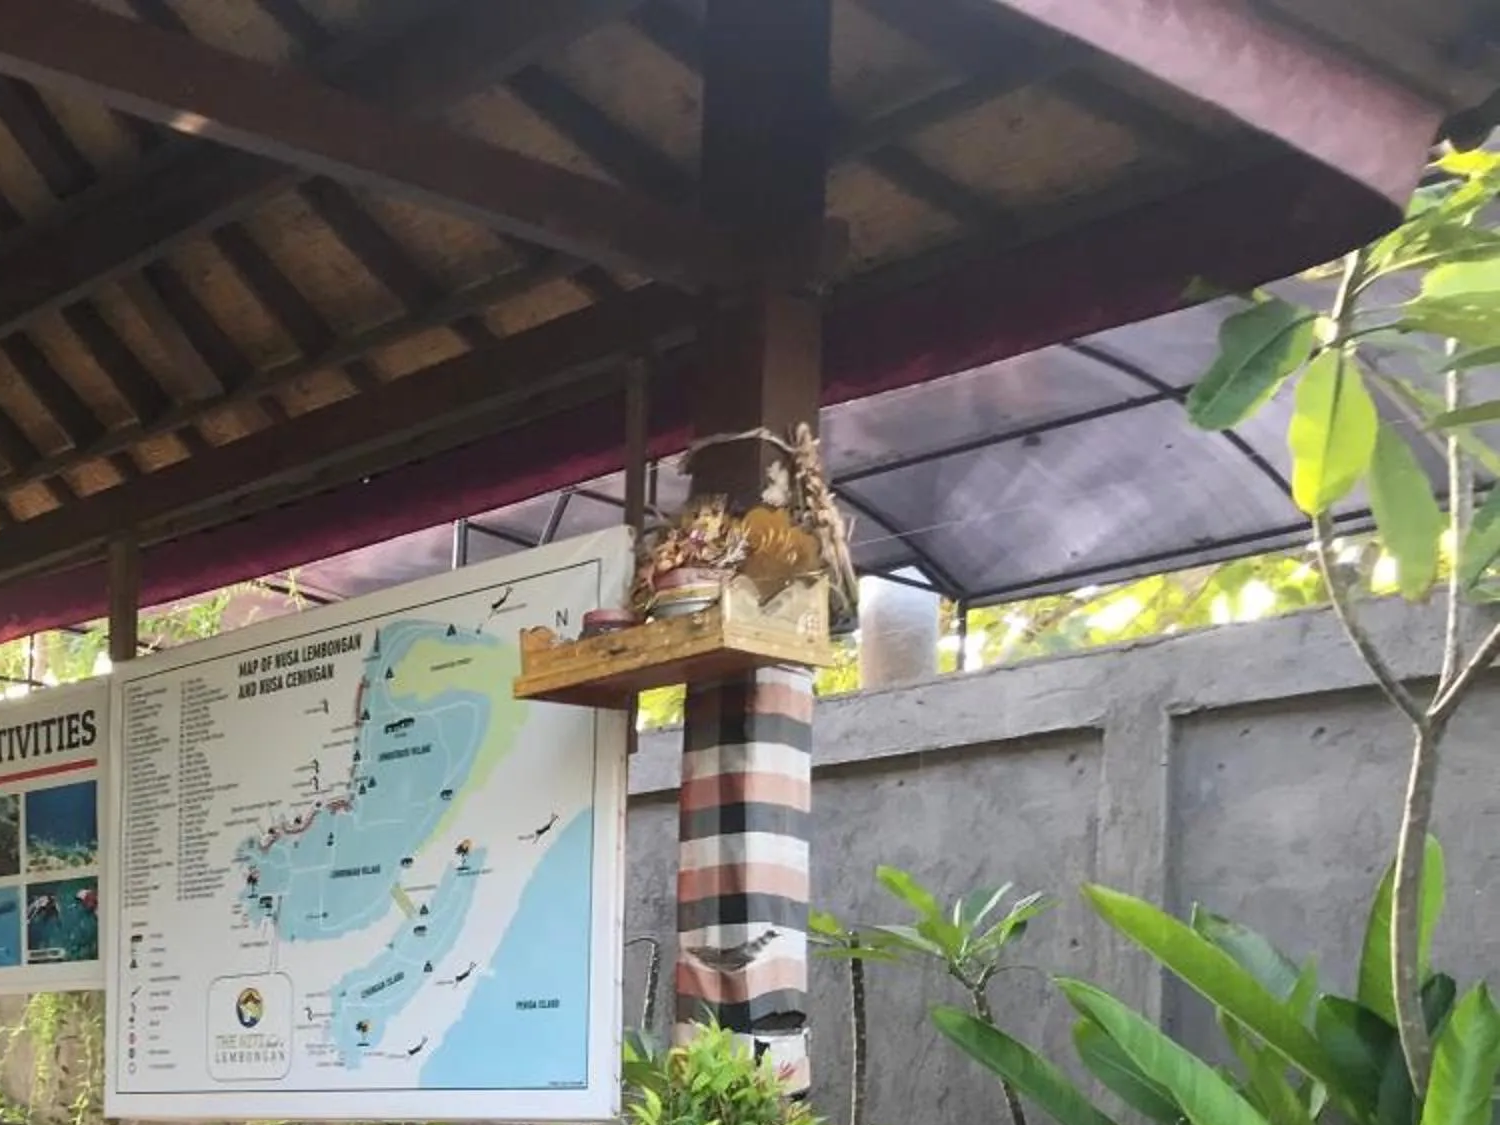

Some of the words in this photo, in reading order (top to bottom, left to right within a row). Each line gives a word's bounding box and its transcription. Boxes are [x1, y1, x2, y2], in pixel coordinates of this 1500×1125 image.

[238, 659, 259, 677] MAP
[260, 655, 273, 673] OF
[275, 649, 300, 669] NUSA
[301, 633, 362, 662] LEMBONGAN
[237, 681, 257, 700] AND
[259, 675, 283, 695] NUSA
[285, 663, 335, 689] CENINGAN
